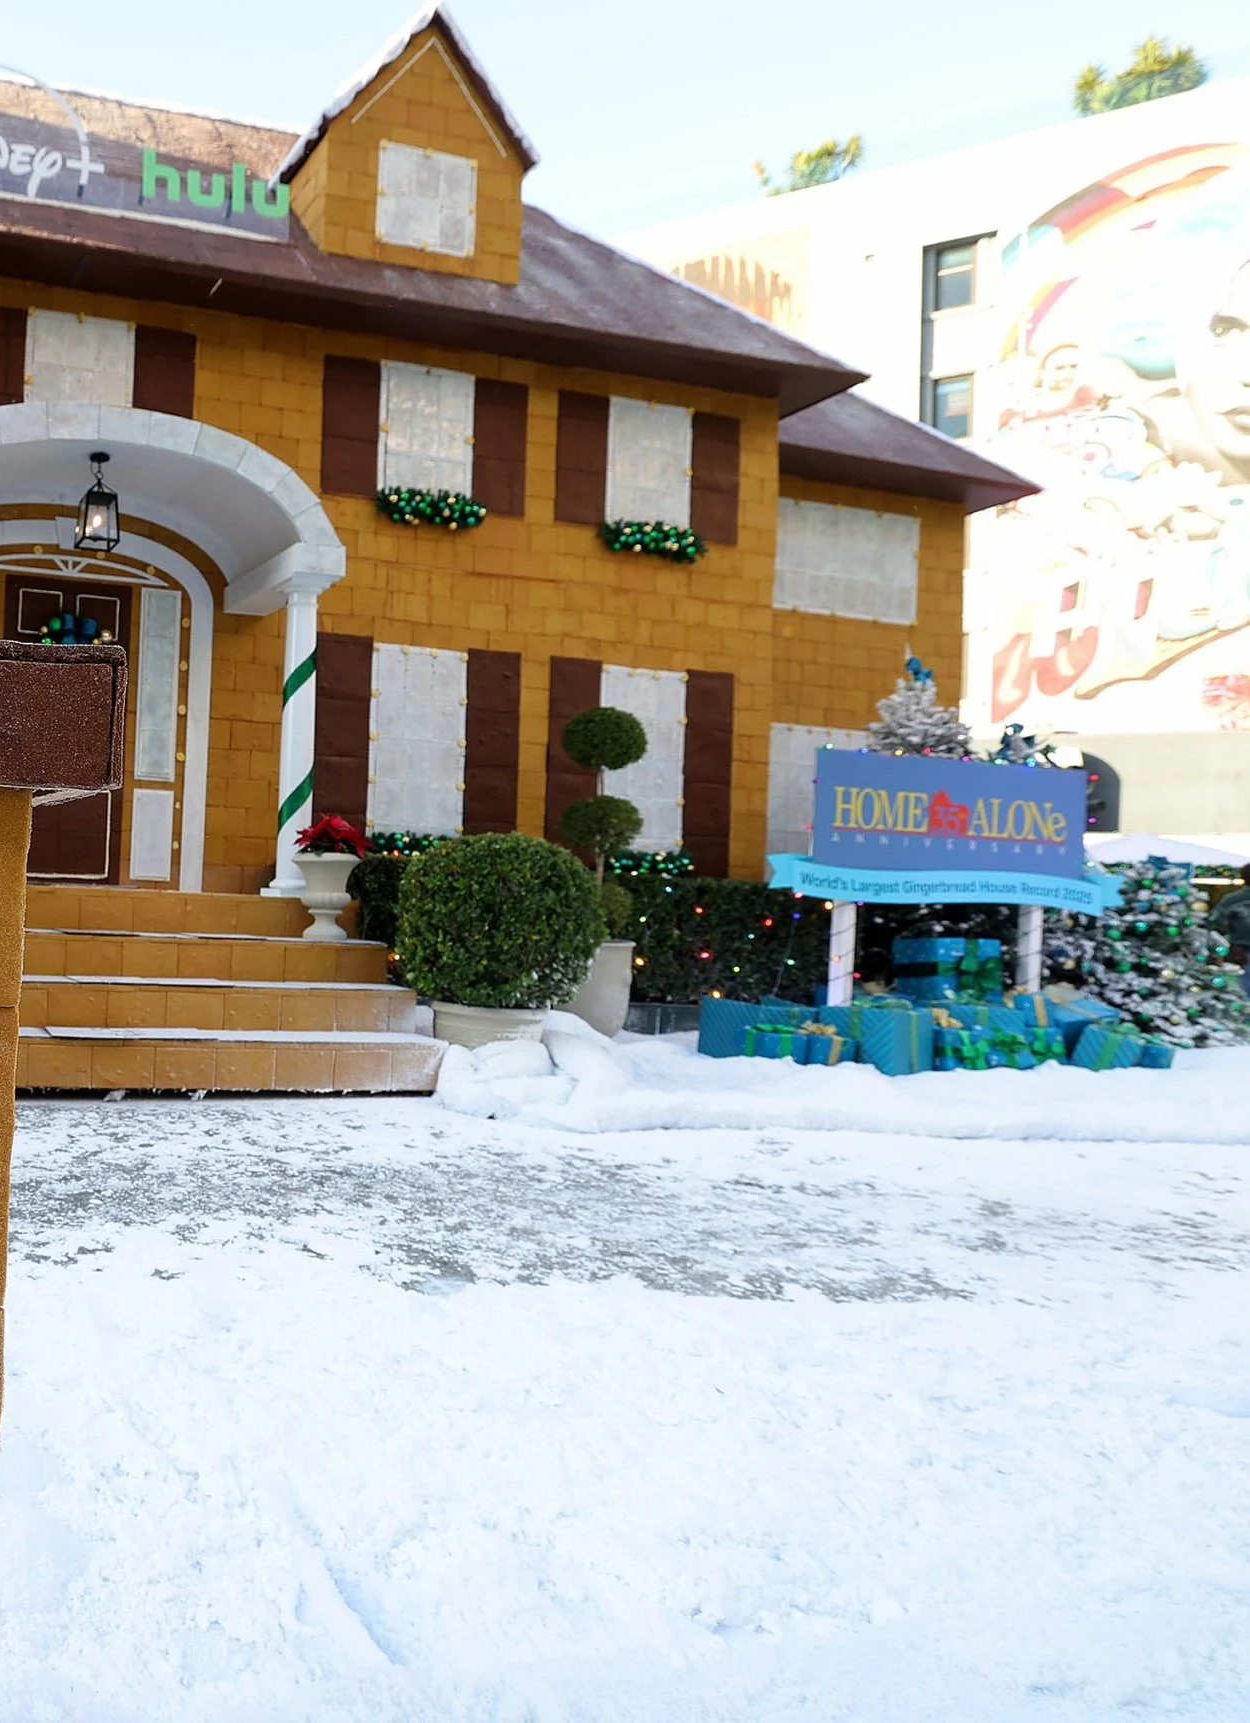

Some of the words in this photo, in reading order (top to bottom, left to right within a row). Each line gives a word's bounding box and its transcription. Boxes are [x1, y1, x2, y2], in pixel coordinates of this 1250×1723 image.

[142, 147, 290, 218] hulu
[832, 785, 929, 833] HOME
[800, 871, 849, 892] World's
[851, 878, 900, 896] Largest
[902, 880, 977, 896] Gingerbread
[979, 880, 1017, 895] House
